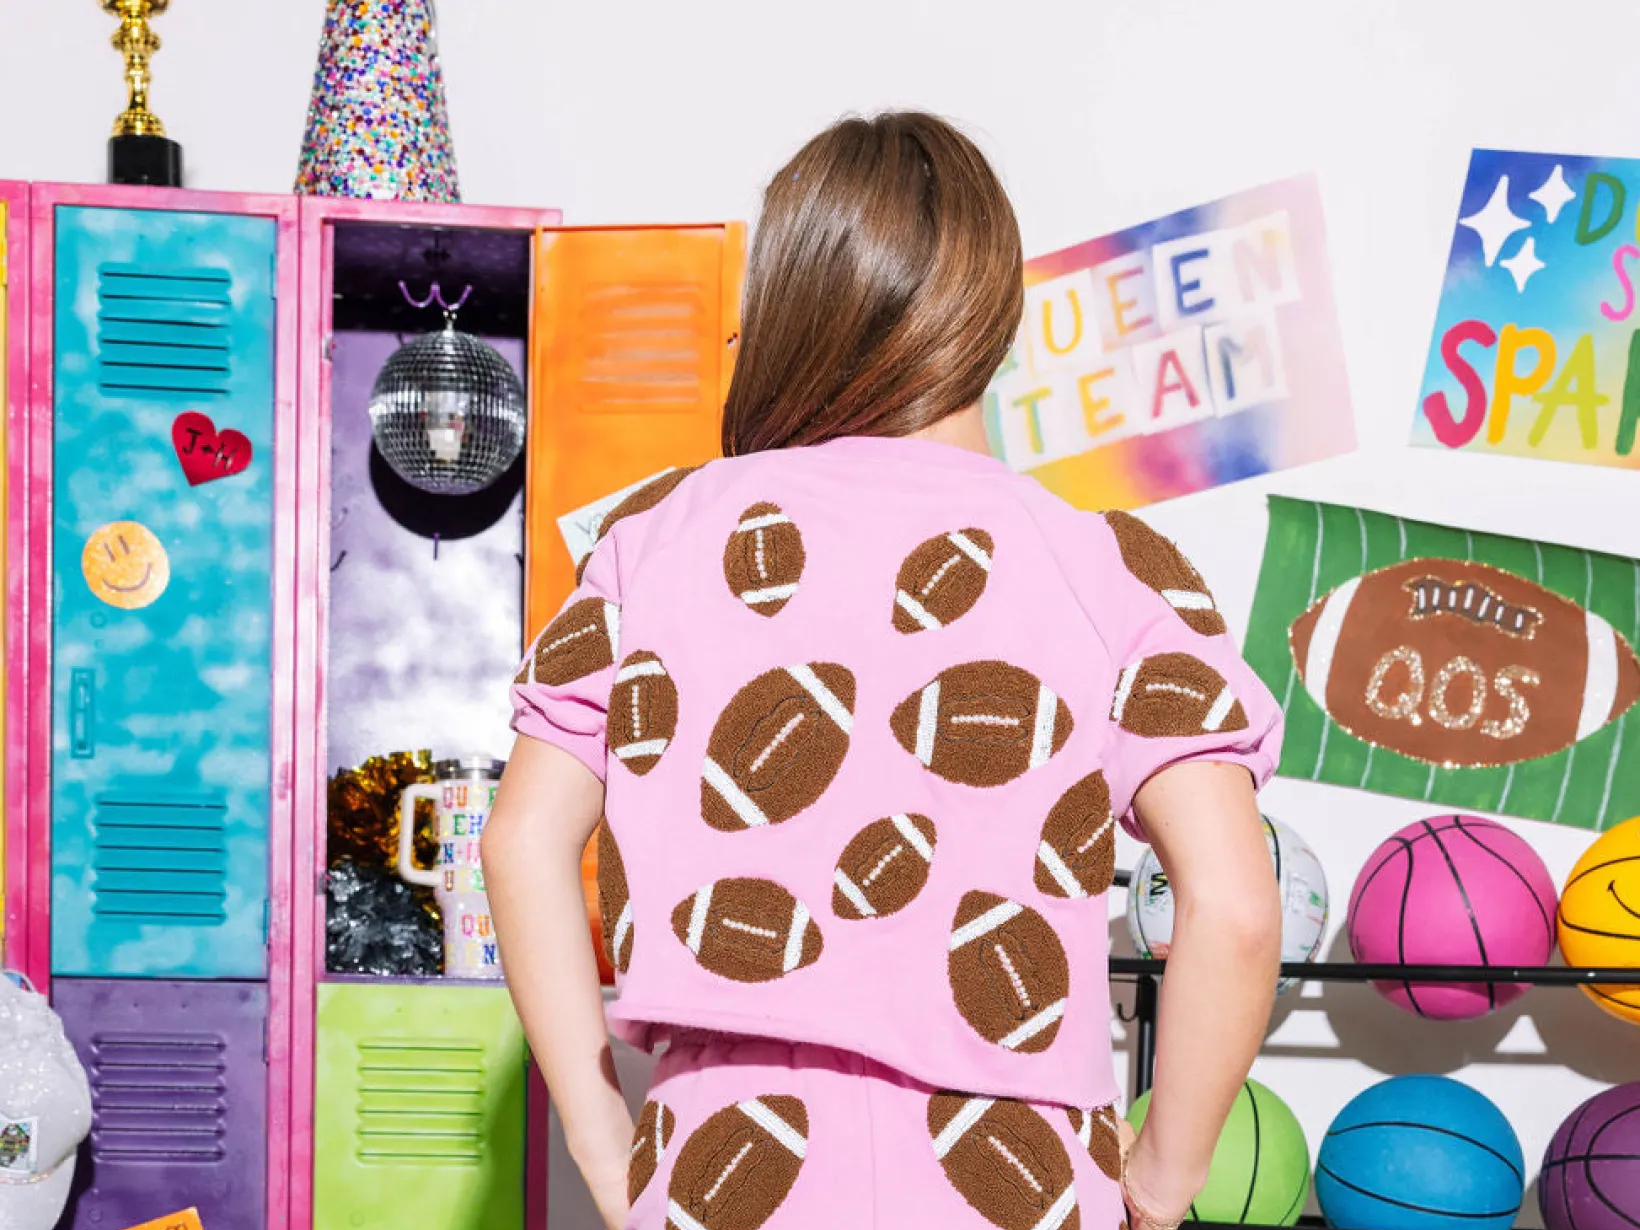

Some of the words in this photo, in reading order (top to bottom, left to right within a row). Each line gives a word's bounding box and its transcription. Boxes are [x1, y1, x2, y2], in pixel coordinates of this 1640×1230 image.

[1575, 171, 1640, 246] D
[996, 229, 1284, 378] UEEN
[1012, 328, 1275, 454] TEAM
[1365, 645, 1541, 740] QOS
